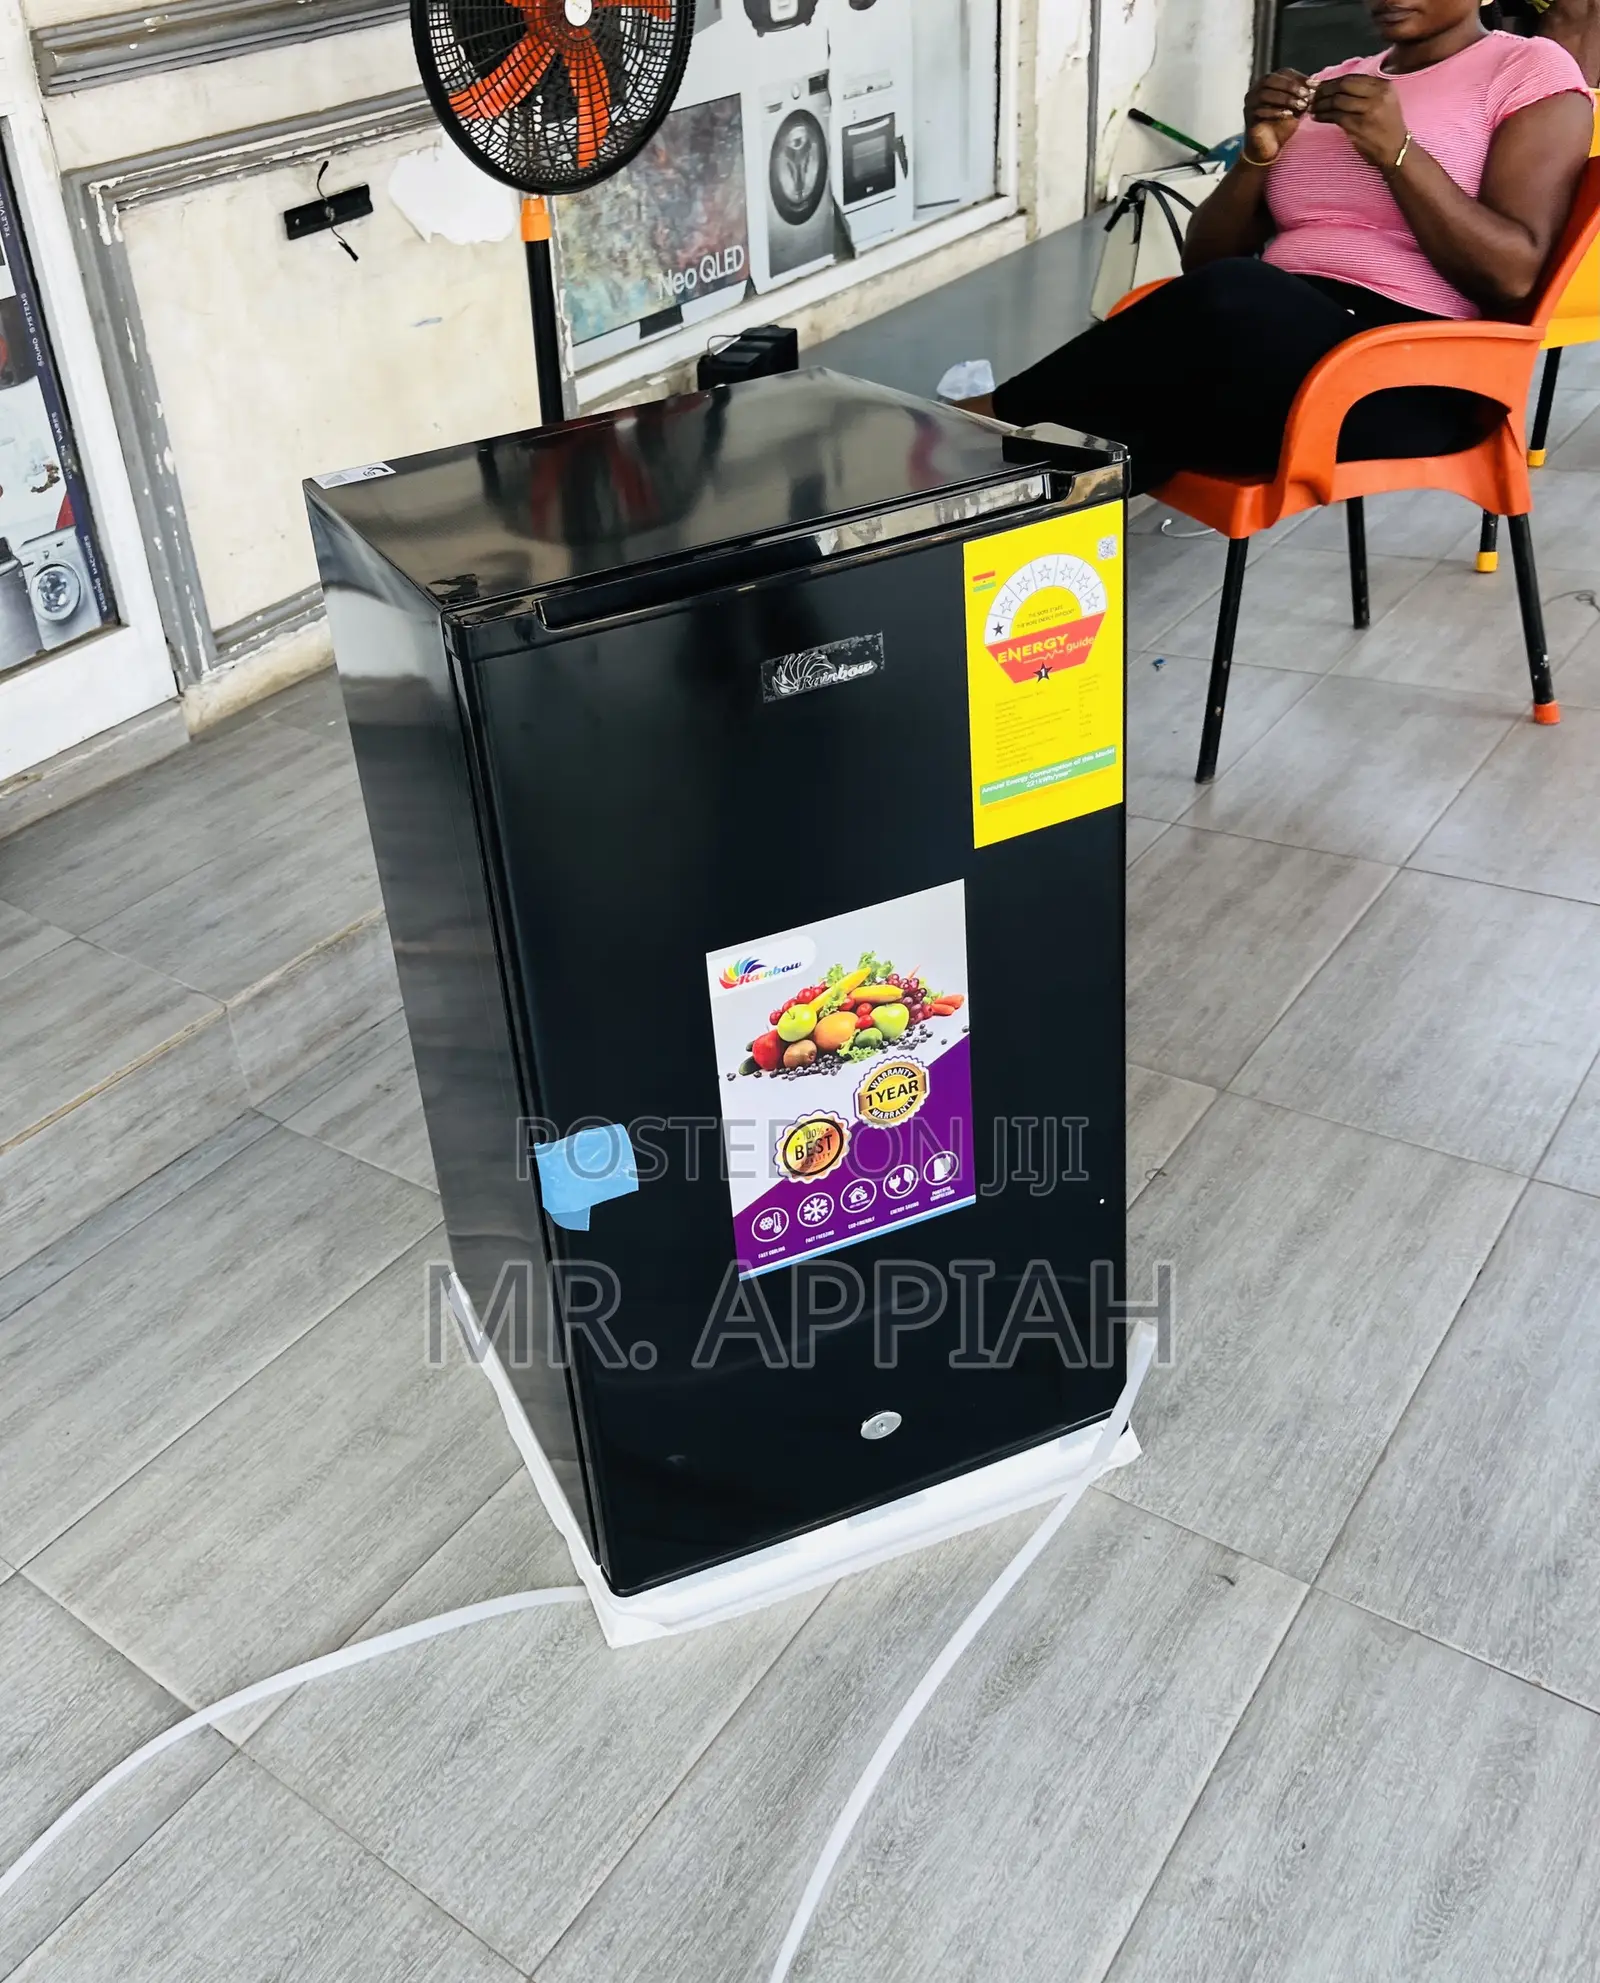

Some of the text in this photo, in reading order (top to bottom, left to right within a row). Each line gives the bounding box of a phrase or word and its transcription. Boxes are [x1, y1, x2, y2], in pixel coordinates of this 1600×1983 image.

[658, 245, 744, 300] Neo QLED
[21, 293, 45, 367] SOUND SYSTEMS
[997, 633, 1095, 664] ENERGY guide
[1040, 668, 1046, 677] 1
[981, 747, 1115, 794] Annual Energy Consumption of this Model
[737, 962, 802, 985] Rainbow
[870, 1067, 915, 1089] WARRANTY
[866, 1080, 919, 1107] 1 YEAR
[872, 1097, 915, 1119] WARRANTY
[795, 1134, 833, 1161] BEST
